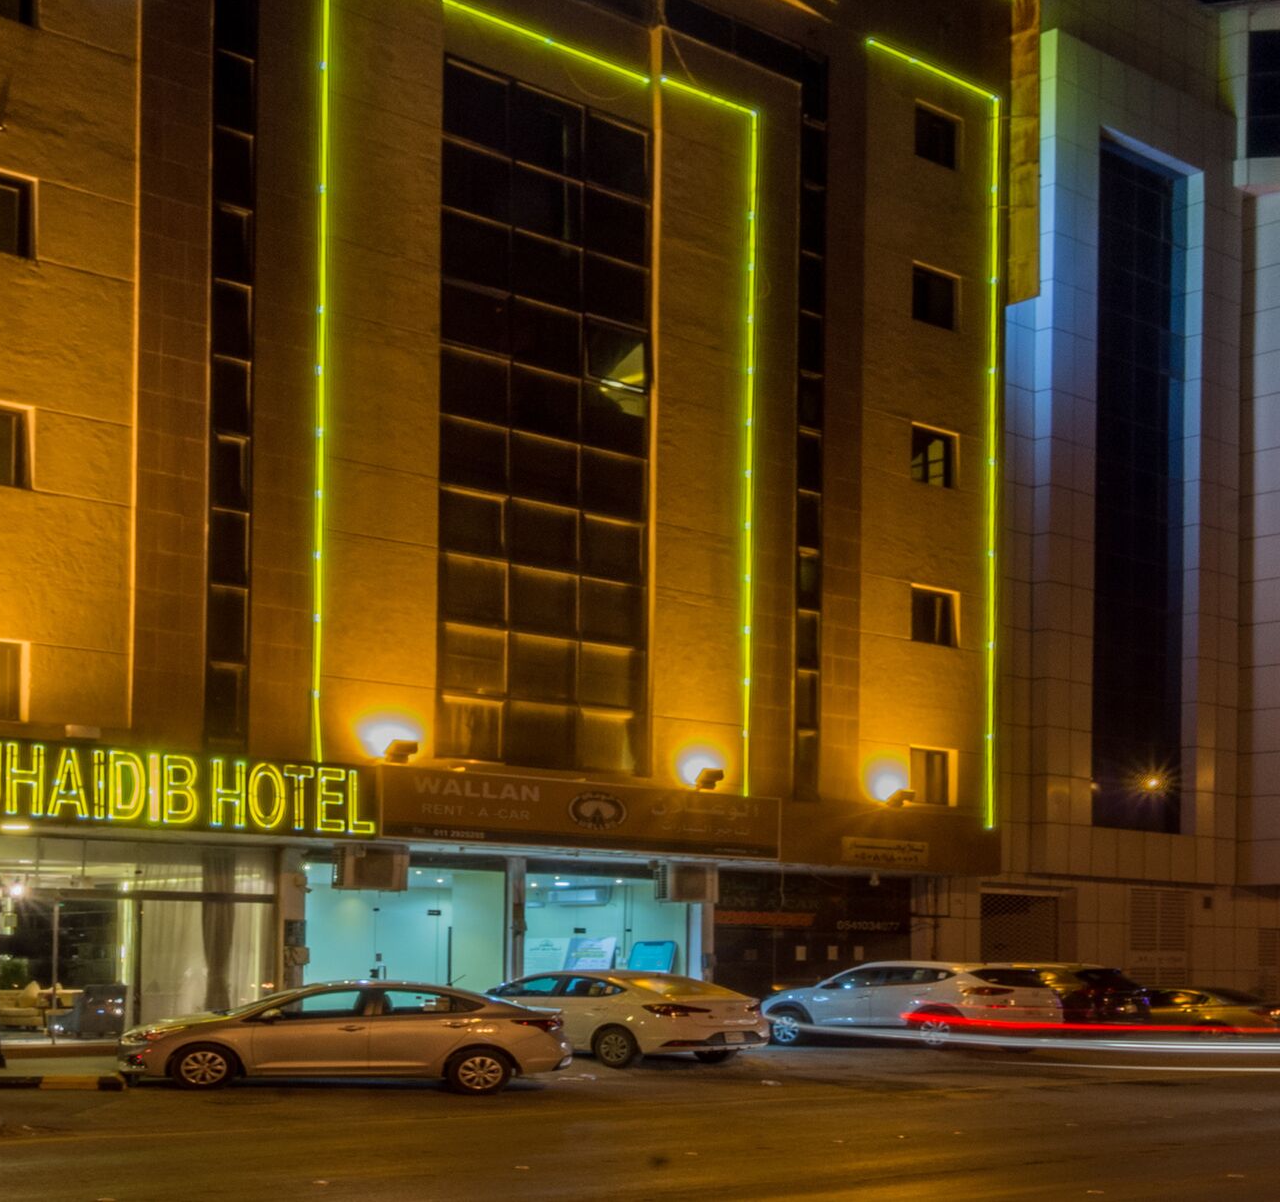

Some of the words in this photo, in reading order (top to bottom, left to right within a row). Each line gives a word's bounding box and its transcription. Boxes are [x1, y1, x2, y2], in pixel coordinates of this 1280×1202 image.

[209, 759, 377, 836] HOTEL
[413, 776, 541, 802] WALLAN
[421, 802, 464, 816] RENT
[498, 808, 531, 821] CAR
